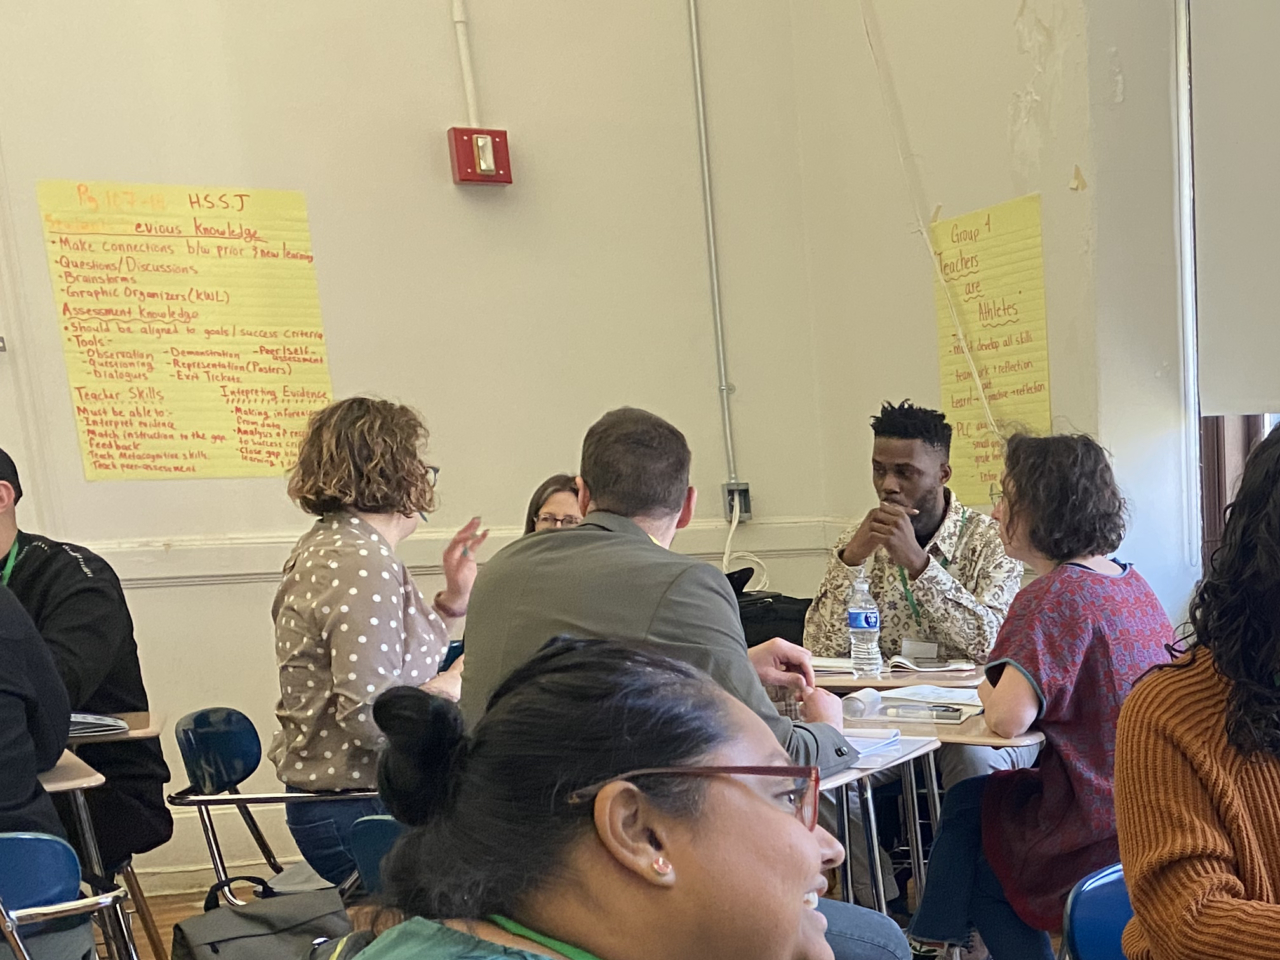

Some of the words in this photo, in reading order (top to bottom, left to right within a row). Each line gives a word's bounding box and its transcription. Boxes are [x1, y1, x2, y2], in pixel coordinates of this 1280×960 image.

[951, 223, 981, 244] Group
[60, 236, 95, 252] Make
[260, 248, 279, 258] new
[64, 271, 137, 284] Brainstorms
[66, 286, 119, 301] Graphic
[965, 280, 983, 296] are
[63, 302, 132, 316] Assessment
[116, 322, 134, 333] be
[141, 325, 178, 339] aligned
[186, 326, 196, 334] to
[976, 338, 1000, 352] develop
[1003, 334, 1013, 348] all
[87, 348, 154, 361] Observation
[170, 347, 240, 359] Demonstration
[89, 358, 154, 373] Questioning
[955, 365, 990, 382] teamork
[998, 359, 1034, 374] reflection
[177, 370, 199, 380] Exit
[74, 387, 119, 401] Teacher
[129, 387, 164, 400] Skills
[76, 406, 107, 416] Must
[112, 407, 125, 417] be
[130, 406, 150, 417] able
[235, 406, 270, 420] Making
[84, 417, 133, 428] Interpret
[261, 421, 281, 429] data
[956, 421, 973, 438] PLC
[87, 429, 120, 439] Match
[123, 430, 174, 440] instruction
[191, 431, 206, 440] the
[211, 434, 226, 444] gap
[237, 427, 272, 439] Analysis
[275, 429, 286, 438] of
[239, 437, 249, 446] to
[239, 446, 262, 455] Close
[265, 450, 281, 461] gap
